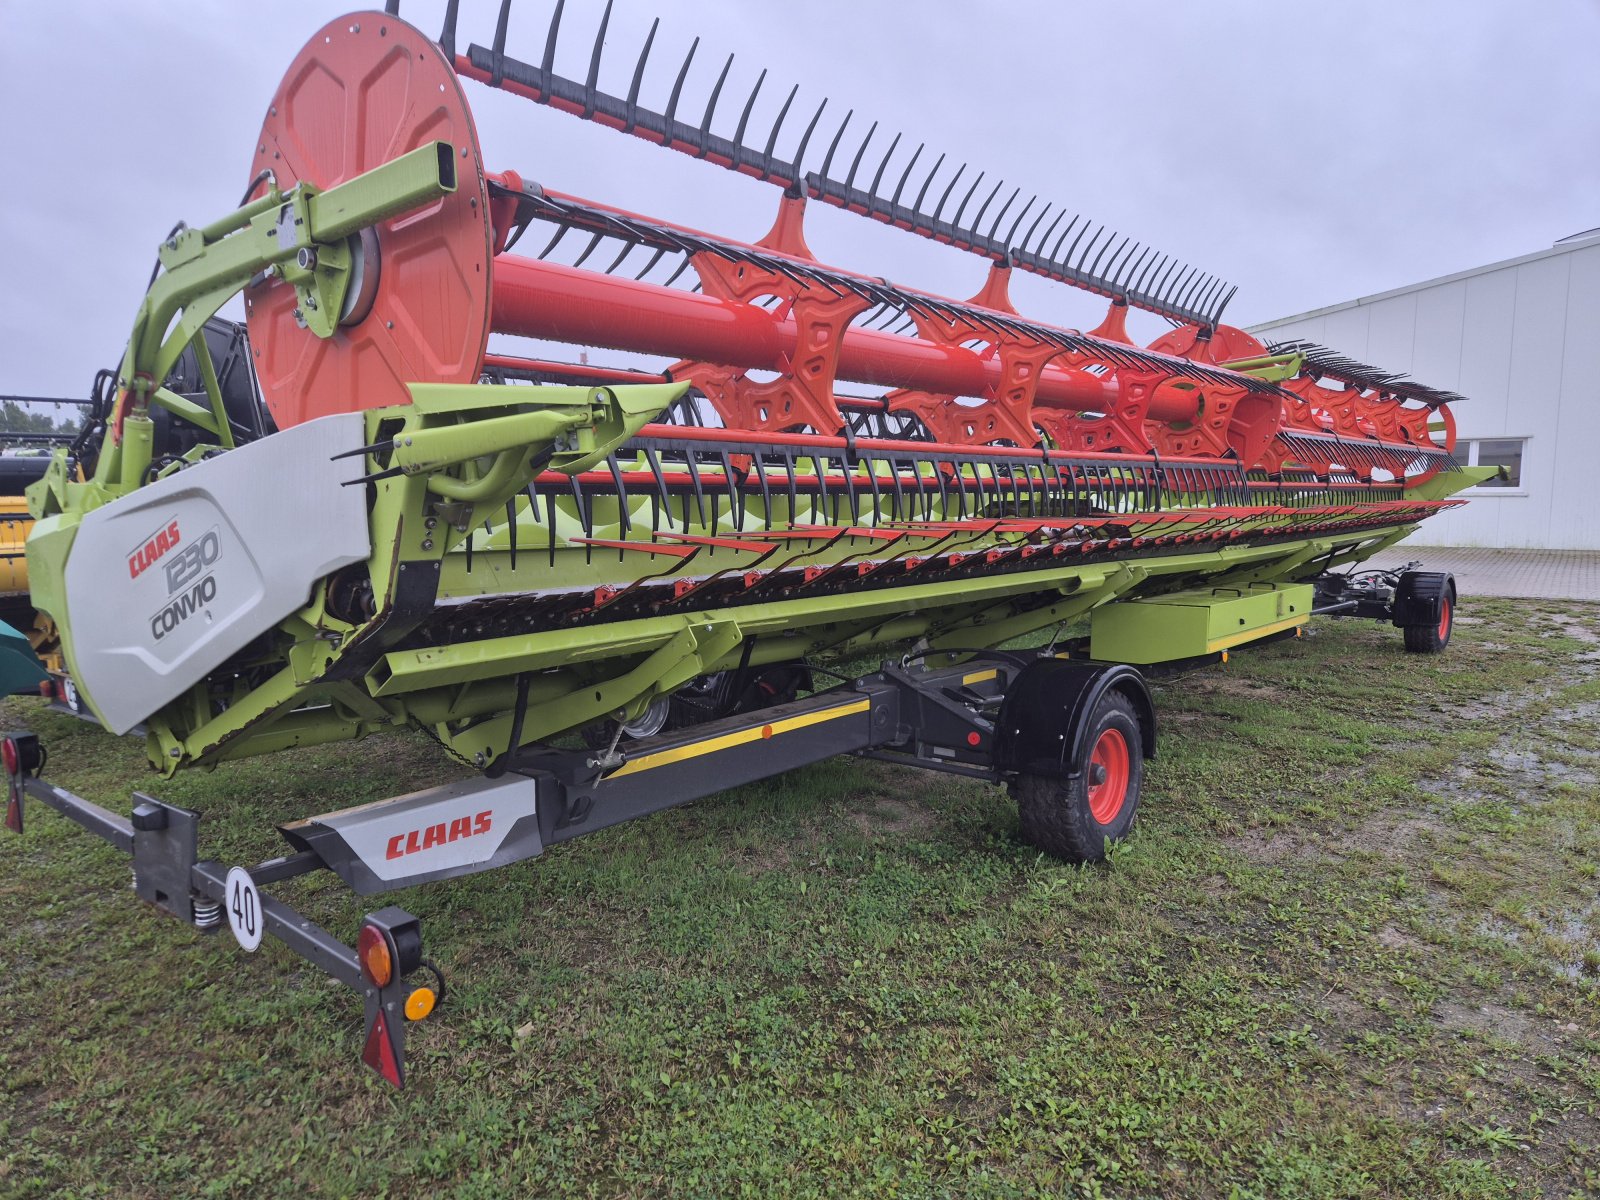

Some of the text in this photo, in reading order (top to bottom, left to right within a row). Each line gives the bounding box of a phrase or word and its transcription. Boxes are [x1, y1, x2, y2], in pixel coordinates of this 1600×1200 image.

[128, 520, 181, 580] CLAAS
[166, 531, 219, 595] 1230
[151, 575, 217, 640] CONVIO
[385, 809, 493, 861] CLAAS
[232, 880, 255, 937] 40
